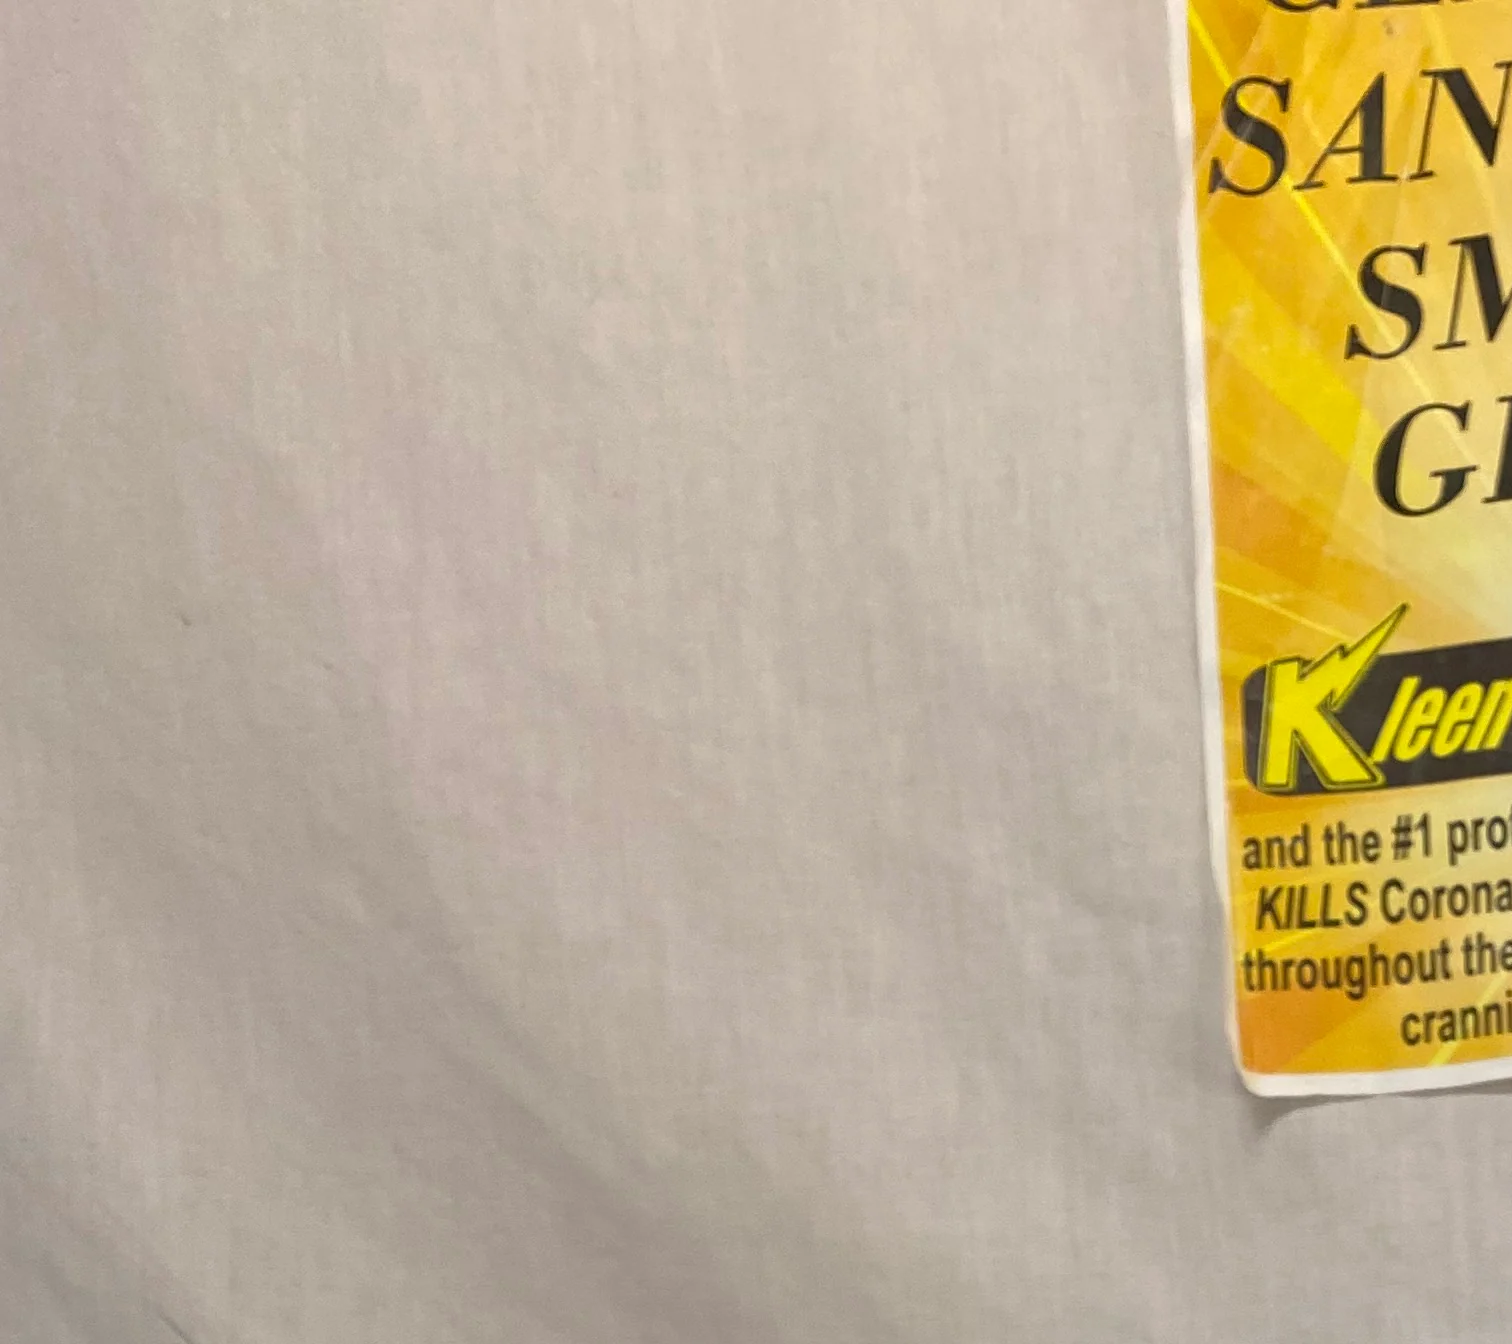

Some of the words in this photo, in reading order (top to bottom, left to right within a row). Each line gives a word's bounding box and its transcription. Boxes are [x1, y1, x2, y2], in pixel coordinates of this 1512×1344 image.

[1243, 823, 1311, 871] and
[1324, 819, 1381, 863] the
[1392, 813, 1432, 860] #1
[1256, 881, 1370, 931] KILLS
[1242, 940, 1453, 1000] throughout
